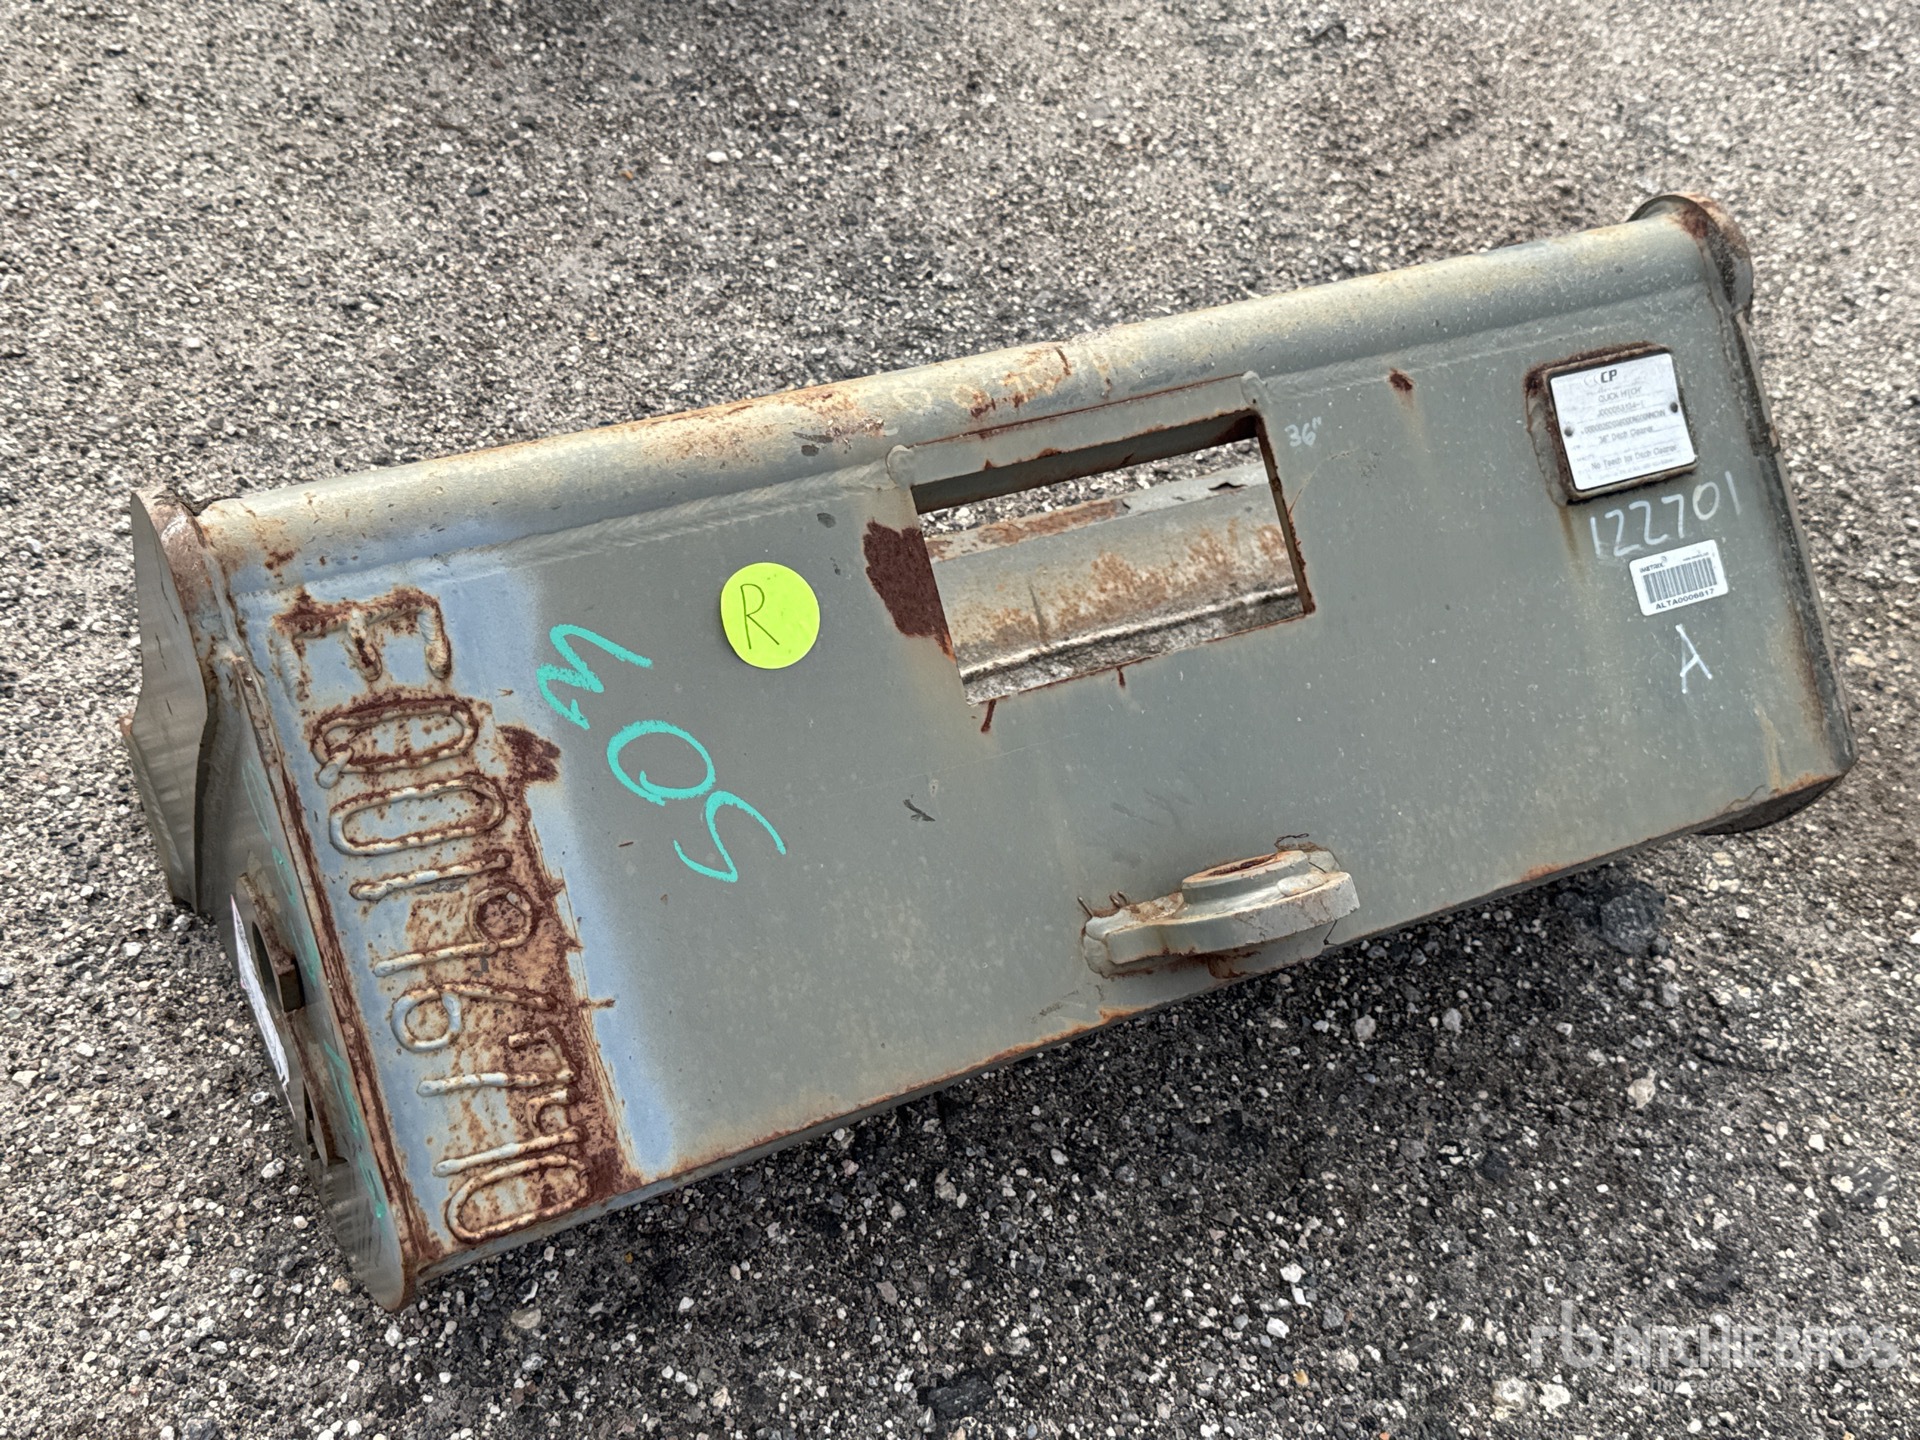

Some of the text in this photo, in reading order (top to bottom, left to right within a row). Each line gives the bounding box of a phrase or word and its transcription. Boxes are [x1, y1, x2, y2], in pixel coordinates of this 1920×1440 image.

[1598, 392, 1618, 402] QUICK
[1600, 369, 1618, 383] CP
[1284, 416, 1321, 446] 36"
[1591, 471, 1741, 557] 122701
[740, 583, 780, 650] R
[1675, 624, 1712, 693] A
